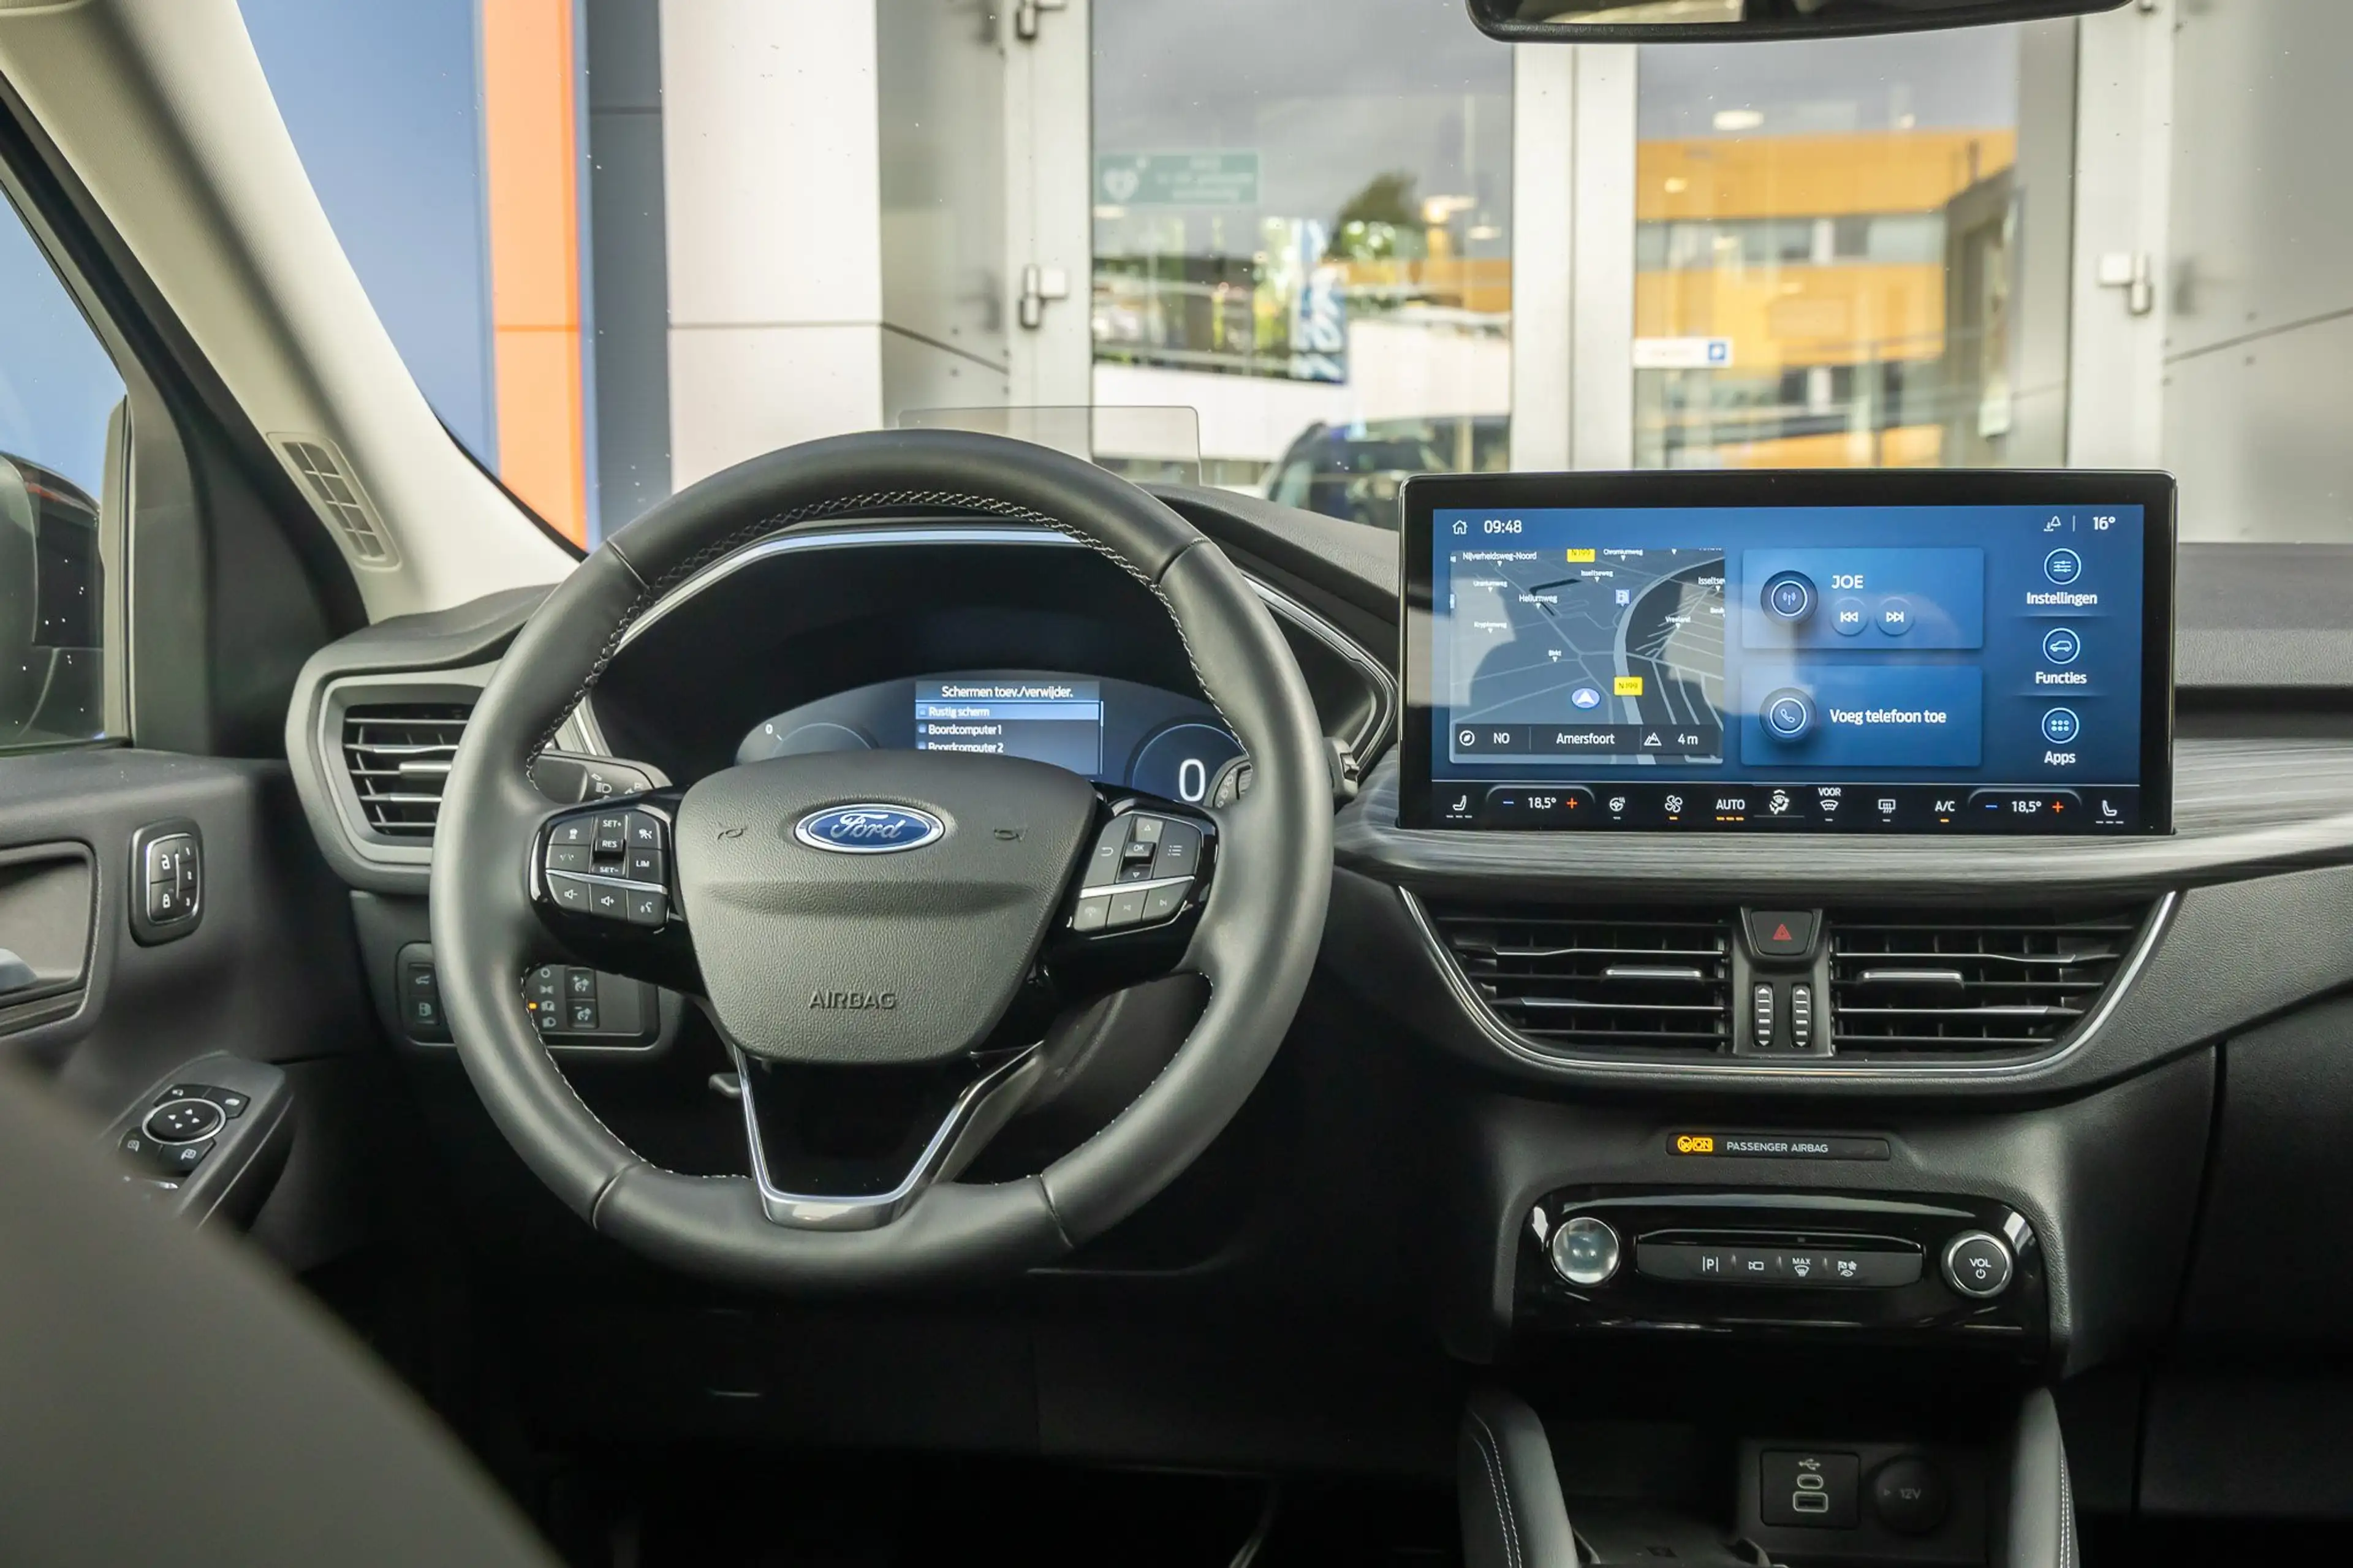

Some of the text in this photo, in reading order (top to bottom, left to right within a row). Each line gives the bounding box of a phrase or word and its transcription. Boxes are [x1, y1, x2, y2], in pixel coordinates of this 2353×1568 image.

[1483, 520, 1522, 534] 09:48
[2093, 516, 2116, 531] 16°
[1831, 575, 1864, 589] JOE
[1518, 594, 1558, 604] Heliumweg
[2026, 592, 2098, 607] Instellingen
[2035, 672, 2088, 685] Functies
[941, 685, 1074, 699] Schermen toev./verwijder.
[928, 706, 990, 719] Rustig scherm
[1829, 708, 1947, 725] Voeg telefoon toe
[765, 723, 773, 735] 0
[928, 724, 1002, 737] Boordcomputer 1
[1493, 733, 1510, 745] NO
[1556, 732, 1615, 745] Amersfoort
[1677, 734, 1699, 745] 4 m
[997, 742, 1004, 753] 2
[2044, 751, 2076, 766] Apps
[1178, 758, 1206, 802] 0
[1817, 787, 1841, 797] VOOR
[1716, 799, 1745, 811] AUTO
[1934, 801, 1955, 812] A/C
[830, 813, 906, 839] Ford
[602, 840, 617, 849] RES
[635, 860, 650, 868] LIM
[808, 988, 896, 1010] AIRBAG
[1726, 1141, 1788, 1153] PASSENGER
[1790, 1143, 1828, 1153] AIRBAG
[1968, 1257, 1992, 1268] VOL
[1900, 1488, 1922, 1500] 12V
